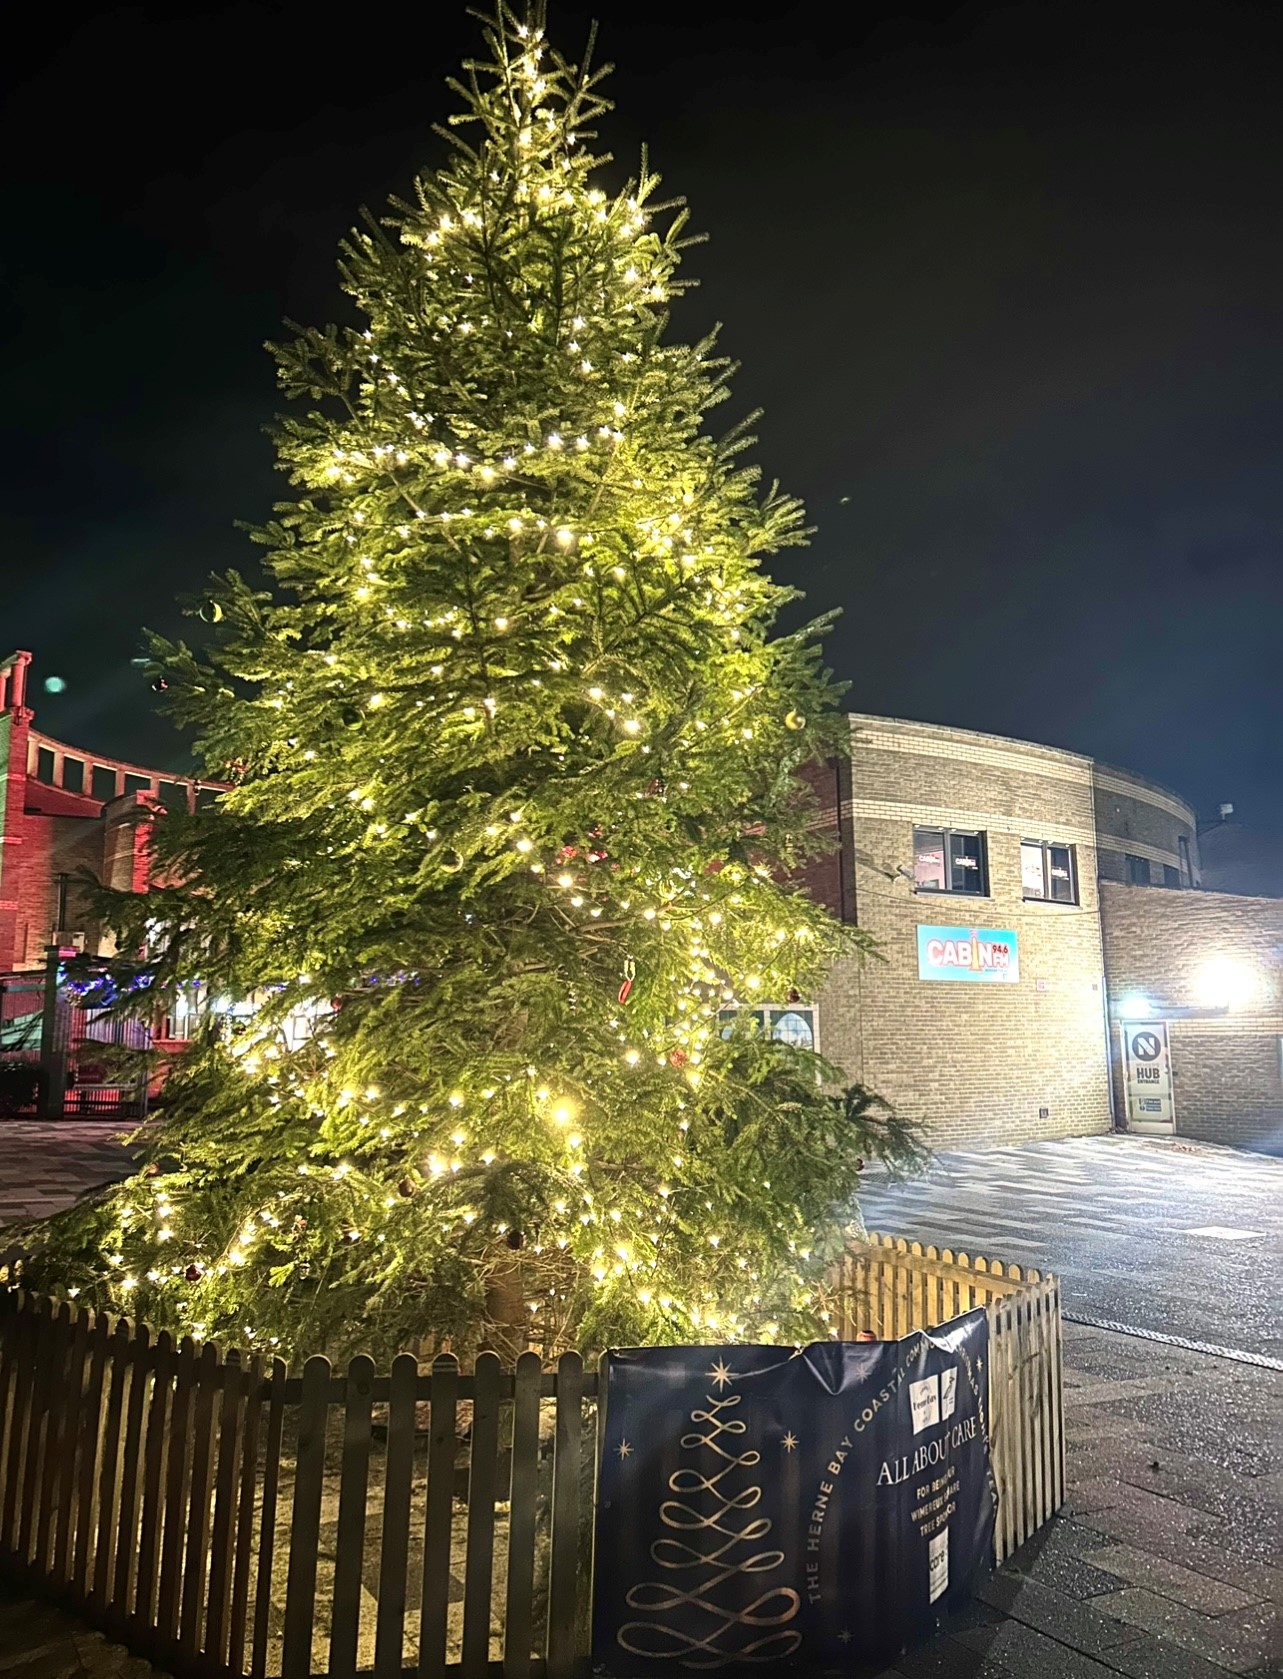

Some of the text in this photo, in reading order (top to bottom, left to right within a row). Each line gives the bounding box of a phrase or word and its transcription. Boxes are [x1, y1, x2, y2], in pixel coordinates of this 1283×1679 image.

[926, 936, 1010, 971] CABIN 94.6 FM
[1136, 1067, 1160, 1079] HUB
[827, 1435, 854, 1475] BAY
[876, 1456, 909, 1486] ALL
[951, 1416, 976, 1449] CARE
[916, 1484, 930, 1500] FOR
[807, 1480, 833, 1550] HERNE
[920, 1521, 935, 1537] TREE
[806, 1562, 822, 1604] THE
